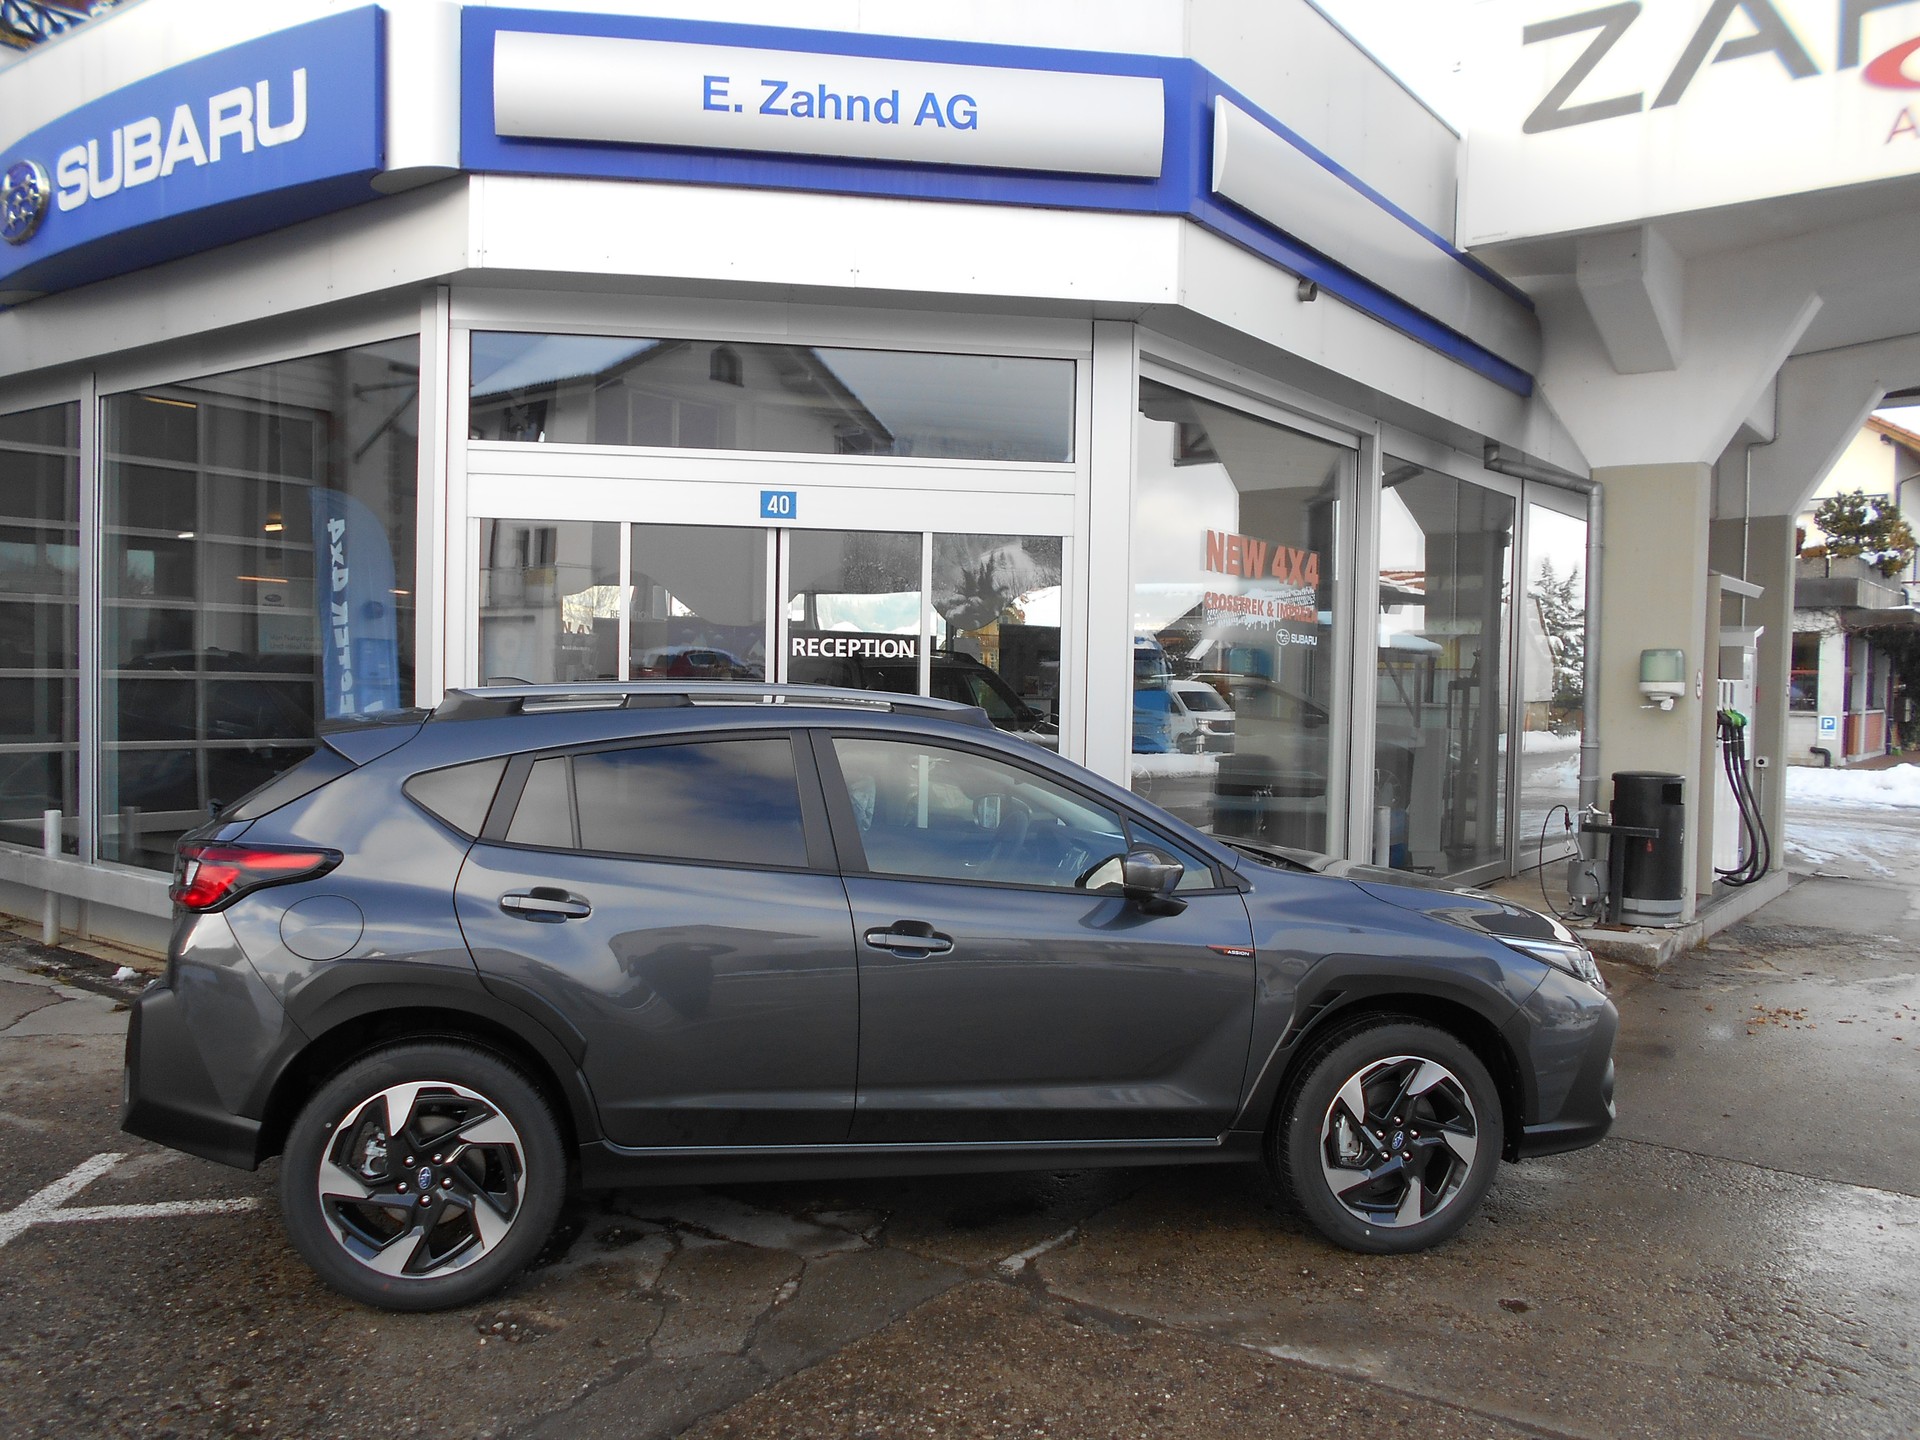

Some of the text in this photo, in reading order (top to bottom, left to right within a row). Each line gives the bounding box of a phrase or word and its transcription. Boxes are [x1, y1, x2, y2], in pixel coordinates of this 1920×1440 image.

[703, 75, 978, 130] E. Zahnd AG
[57, 67, 307, 212] SUBARU
[767, 495, 790, 515] 40
[1206, 530, 1319, 589] NEW 4X4
[1203, 591, 1264, 616] CROSSTREK
[1266, 600, 1275, 618] &
[792, 637, 915, 658] RECEPTION
[1291, 633, 1317, 645] SUBARU
[1823, 718, 1834, 729] P
